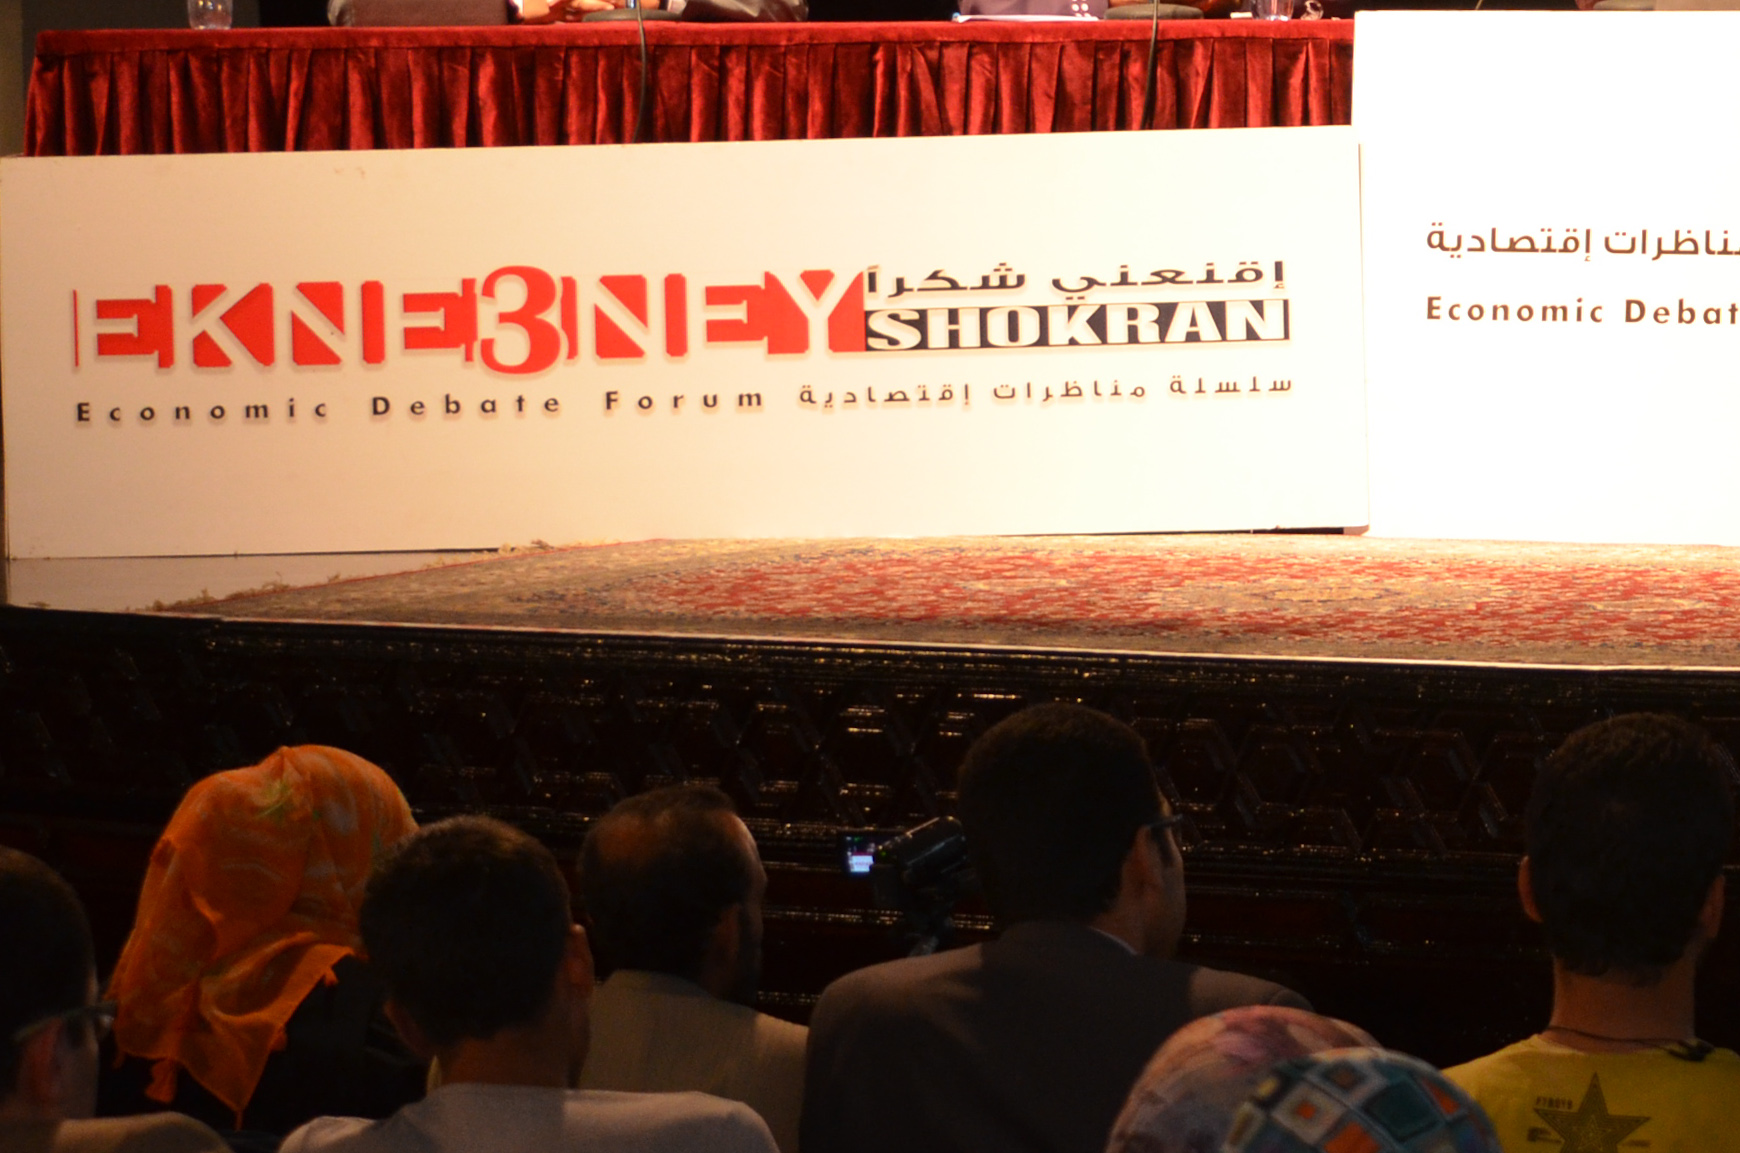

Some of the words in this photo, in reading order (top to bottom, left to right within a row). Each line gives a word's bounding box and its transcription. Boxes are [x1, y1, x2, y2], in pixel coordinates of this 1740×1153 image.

[1426, 222, 1591, 262] إقتصادية
[1426, 296, 1603, 323] Economic
[866, 299, 1290, 351] SHOKRAN
[799, 383, 969, 409] إقتصادية
[993, 380, 1145, 402] مناظرات
[1169, 375, 1292, 395] سلسلة
[76, 398, 326, 423] Economic
[372, 393, 559, 416] Debate
[605, 391, 762, 411] Forum
